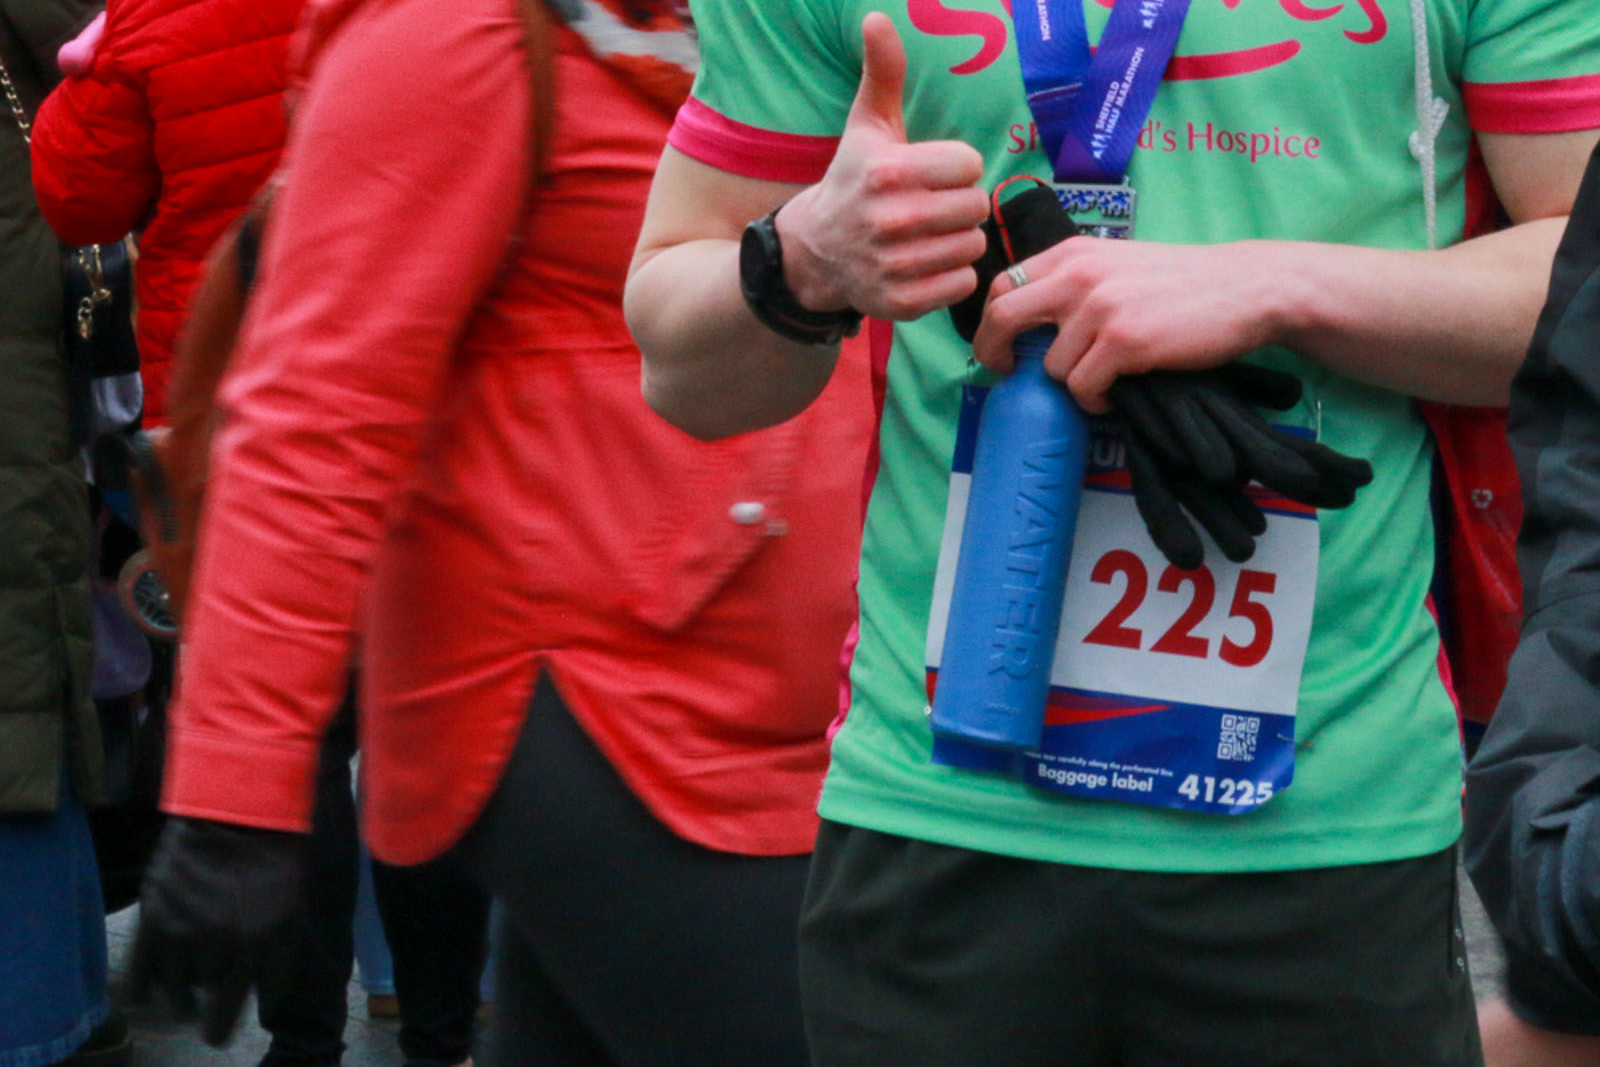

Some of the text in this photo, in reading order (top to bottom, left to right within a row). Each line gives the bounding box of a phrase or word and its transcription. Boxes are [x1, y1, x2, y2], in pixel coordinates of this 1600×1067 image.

[1188, 122, 1321, 164] Hospice
[989, 437, 1070, 680] WATER
[1037, 762, 1154, 792] Baggage label
[1177, 773, 1274, 806] 41225
